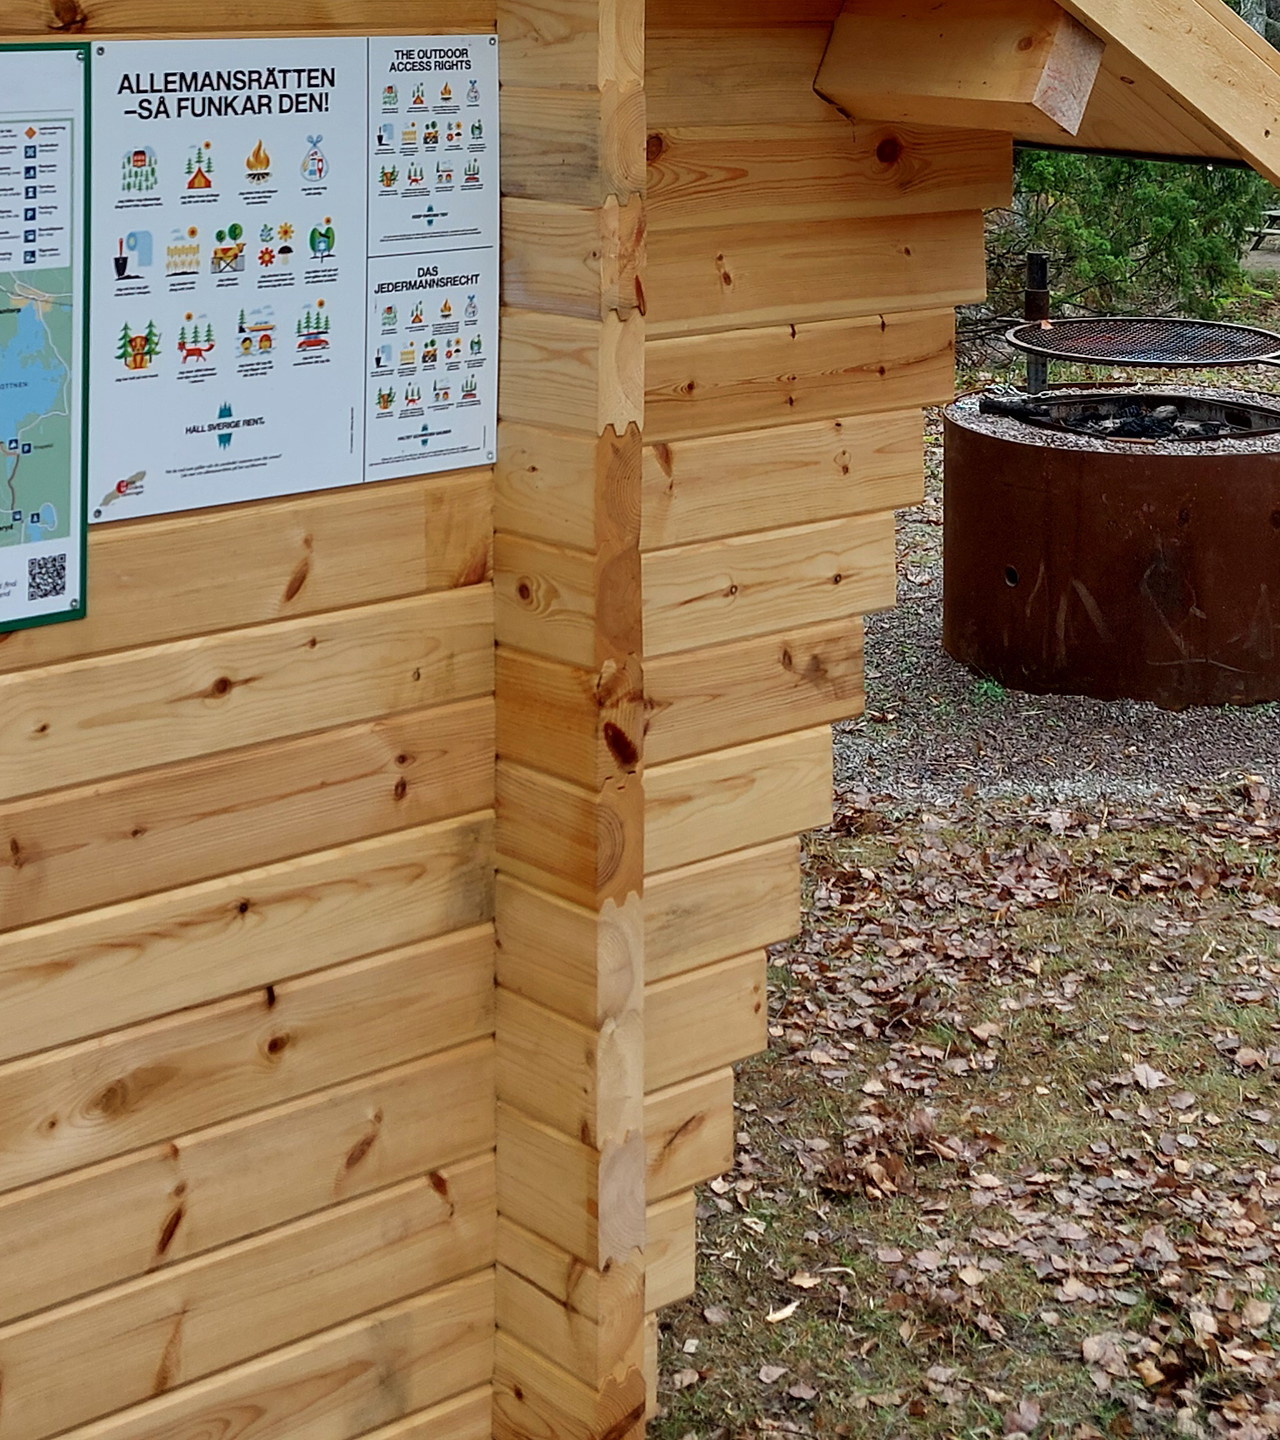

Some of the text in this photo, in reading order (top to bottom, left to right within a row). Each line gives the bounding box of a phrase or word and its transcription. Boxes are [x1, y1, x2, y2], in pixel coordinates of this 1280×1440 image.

[394, 47, 468, 60] THE OUTDOOR
[389, 59, 471, 72] ACCESS RIGHTS
[118, 67, 335, 95] ALLEMANSRÄTTEN
[176, 93, 272, 118] FUNKAR
[278, 91, 329, 114] DEN!
[417, 265, 438, 278] DAS
[373, 273, 479, 294] JEDERMANNSRECHT
